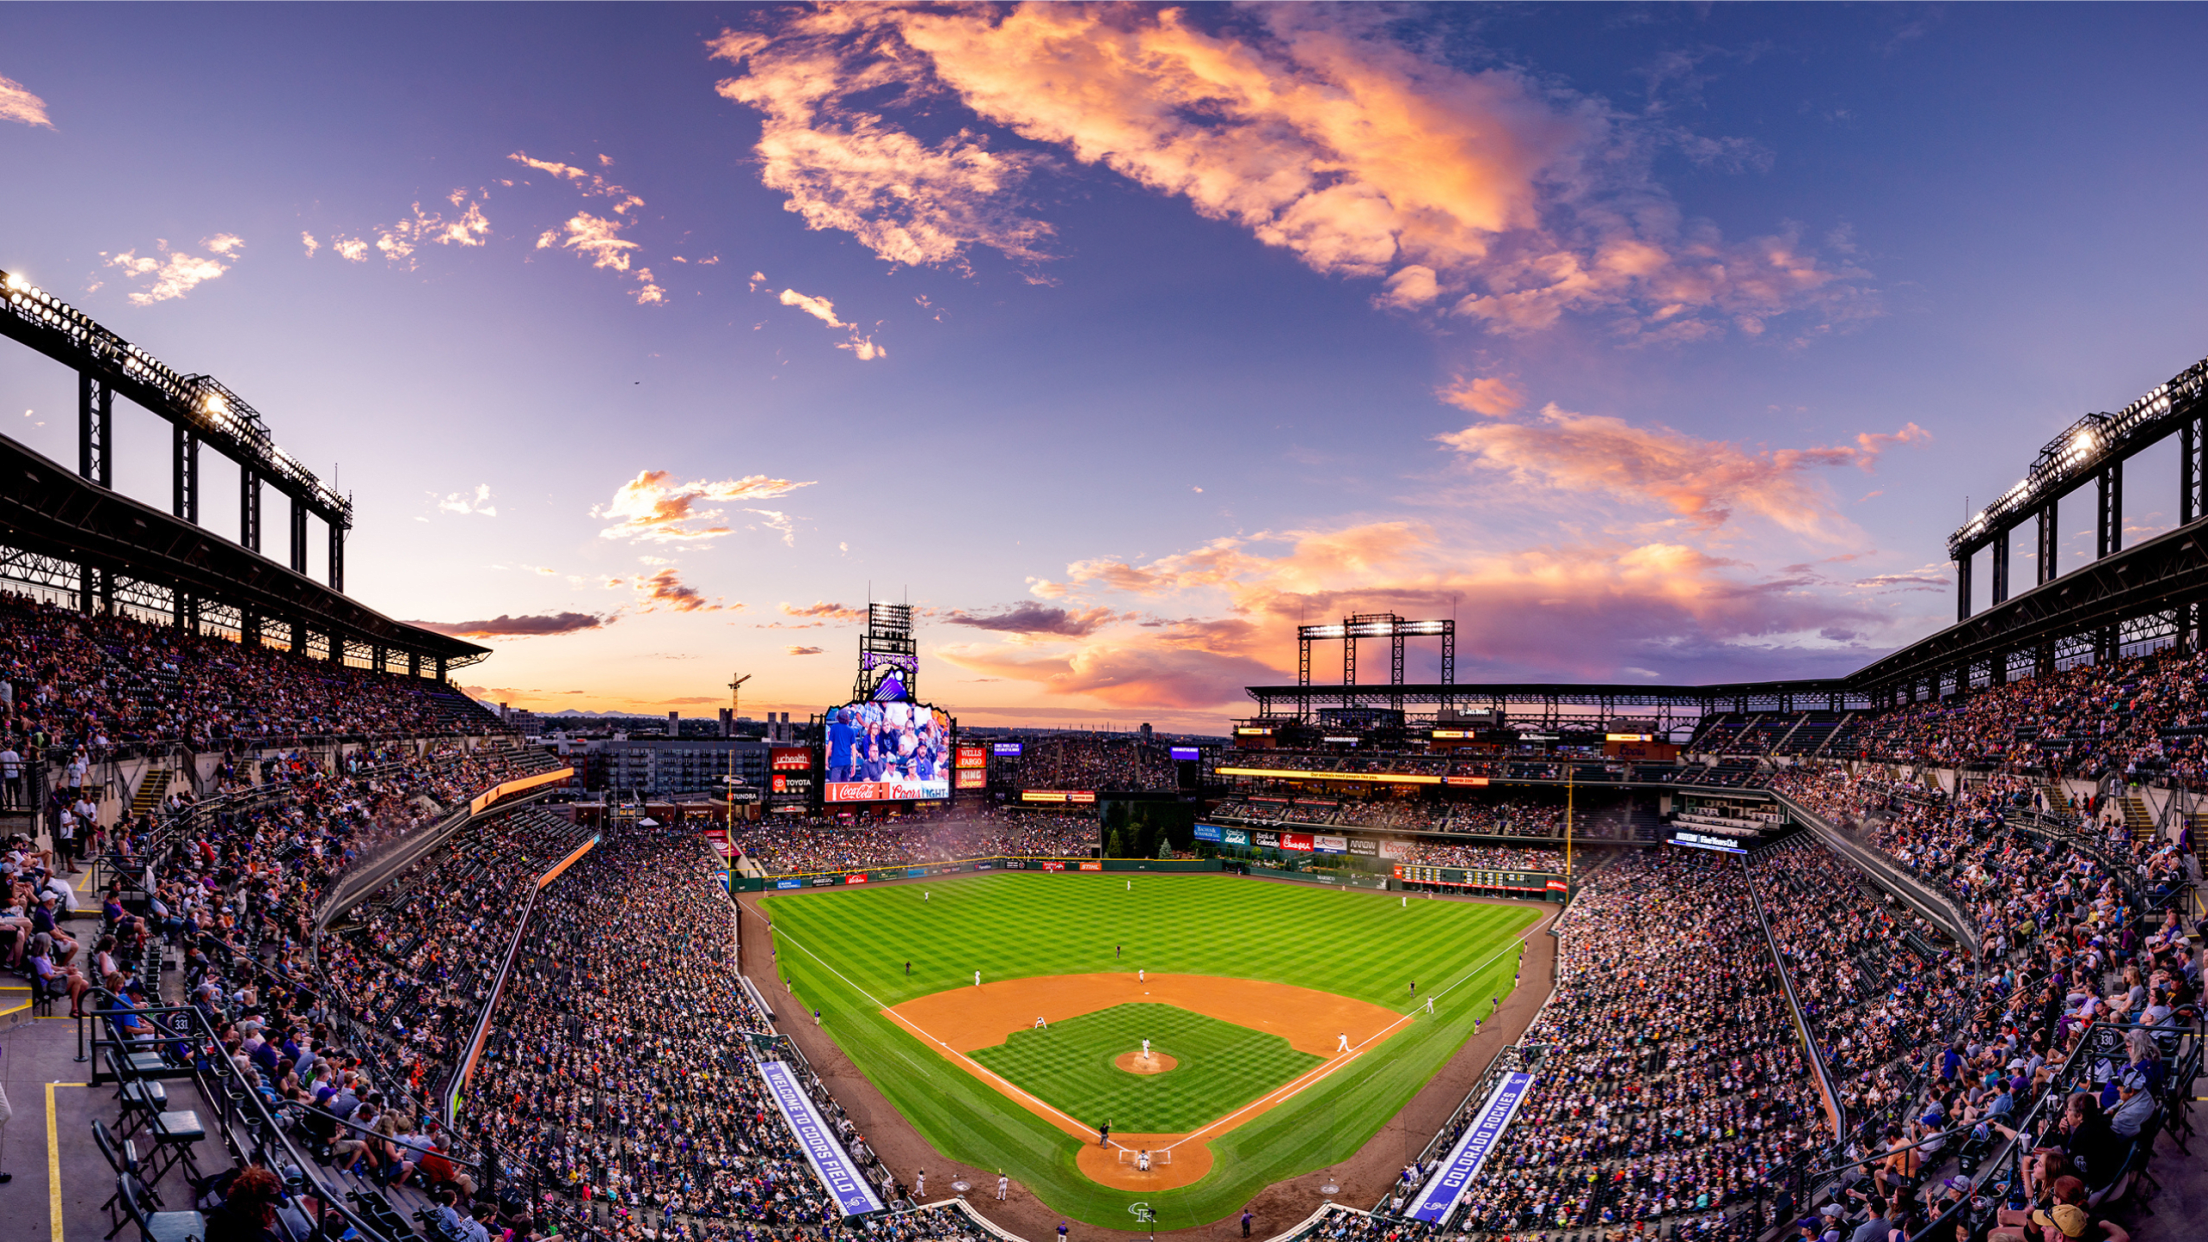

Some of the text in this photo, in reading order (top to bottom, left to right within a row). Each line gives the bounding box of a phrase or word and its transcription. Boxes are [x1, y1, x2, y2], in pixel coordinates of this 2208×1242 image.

[863, 652, 919, 674] ROCKIES
[776, 753, 807, 764] uchealth
[961, 758, 982, 766] FARGO
[961, 771, 982, 780] KING
[892, 784, 921, 799] Coors
[1256, 839, 1280, 848] Colorado
[1385, 841, 1407, 853] Coor
[1726, 839, 1738, 848] Out
[175, 1020, 189, 1030] 331
[2101, 1035, 2114, 1045] 330
[770, 1072, 856, 1193] WELCOME TO COORS FIELD
[1443, 1092, 1516, 1188] COLORADO ROCKIES
